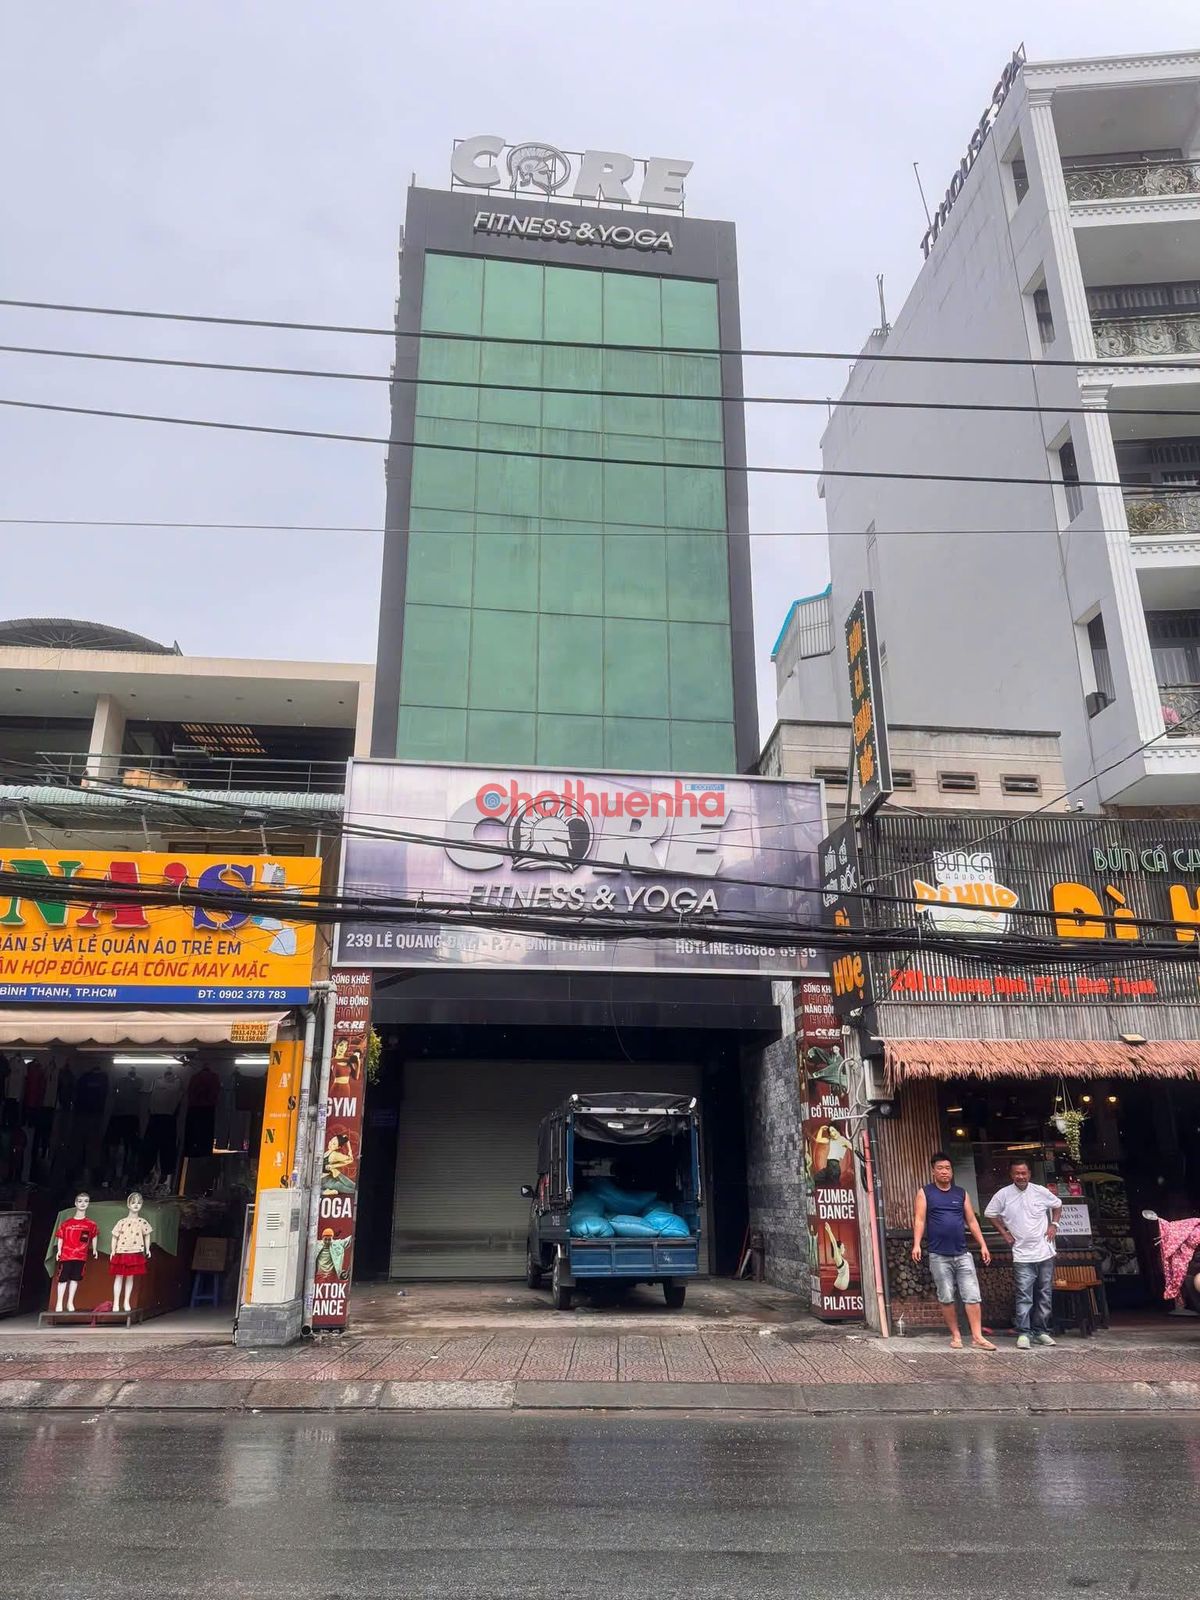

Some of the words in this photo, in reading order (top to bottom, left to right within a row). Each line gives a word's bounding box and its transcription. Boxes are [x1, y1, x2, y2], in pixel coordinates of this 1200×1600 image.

[474, 211, 573, 237] FITNESS
[576, 222, 595, 241] &
[599, 224, 675, 248] YOGA
[1141, 843, 1169, 872] CÁ
[468, 884, 586, 911] FITNESS
[592, 885, 616, 911] &
[625, 886, 719, 914] YOGA
[53, 934, 73, 952] VÀ
[78, 933, 97, 952] LẺ
[102, 933, 149, 956] QUẦN
[153, 936, 177, 954] ÁO
[182, 936, 213, 955] TRẺ
[217, 940, 241, 955] EM
[346, 933, 372, 948] 239
[376, 931, 393, 948] LÊ
[396, 933, 441, 949] QUANG
[21, 958, 57, 978] HỢP
[60, 954, 107, 976] ĐỒNG
[111, 961, 138, 976] GIA
[143, 958, 189, 977] CÔNG
[192, 962, 230, 978] MAY
[232, 960, 270, 980] MẶC
[331, 972, 350, 984] SỐNG
[75, 988, 117, 998] TP.HCM
[198, 989, 216, 999] ĐT:
[219, 989, 244, 999] 0902
[246, 990, 265, 1000] 378
[268, 990, 287, 1000] 783
[803, 982, 821, 993] SỐNG
[821, 984, 832, 993] KH
[326, 1097, 357, 1117] GYM
[822, 1094, 840, 1106] MÚA
[817, 1188, 855, 1204] ZUMBA
[318, 1197, 352, 1218] OGA
[820, 1204, 855, 1219] DANCE
[313, 1283, 347, 1299] IKTOK
[312, 1299, 344, 1316] ANCE
[824, 1296, 863, 1310] PILATES
